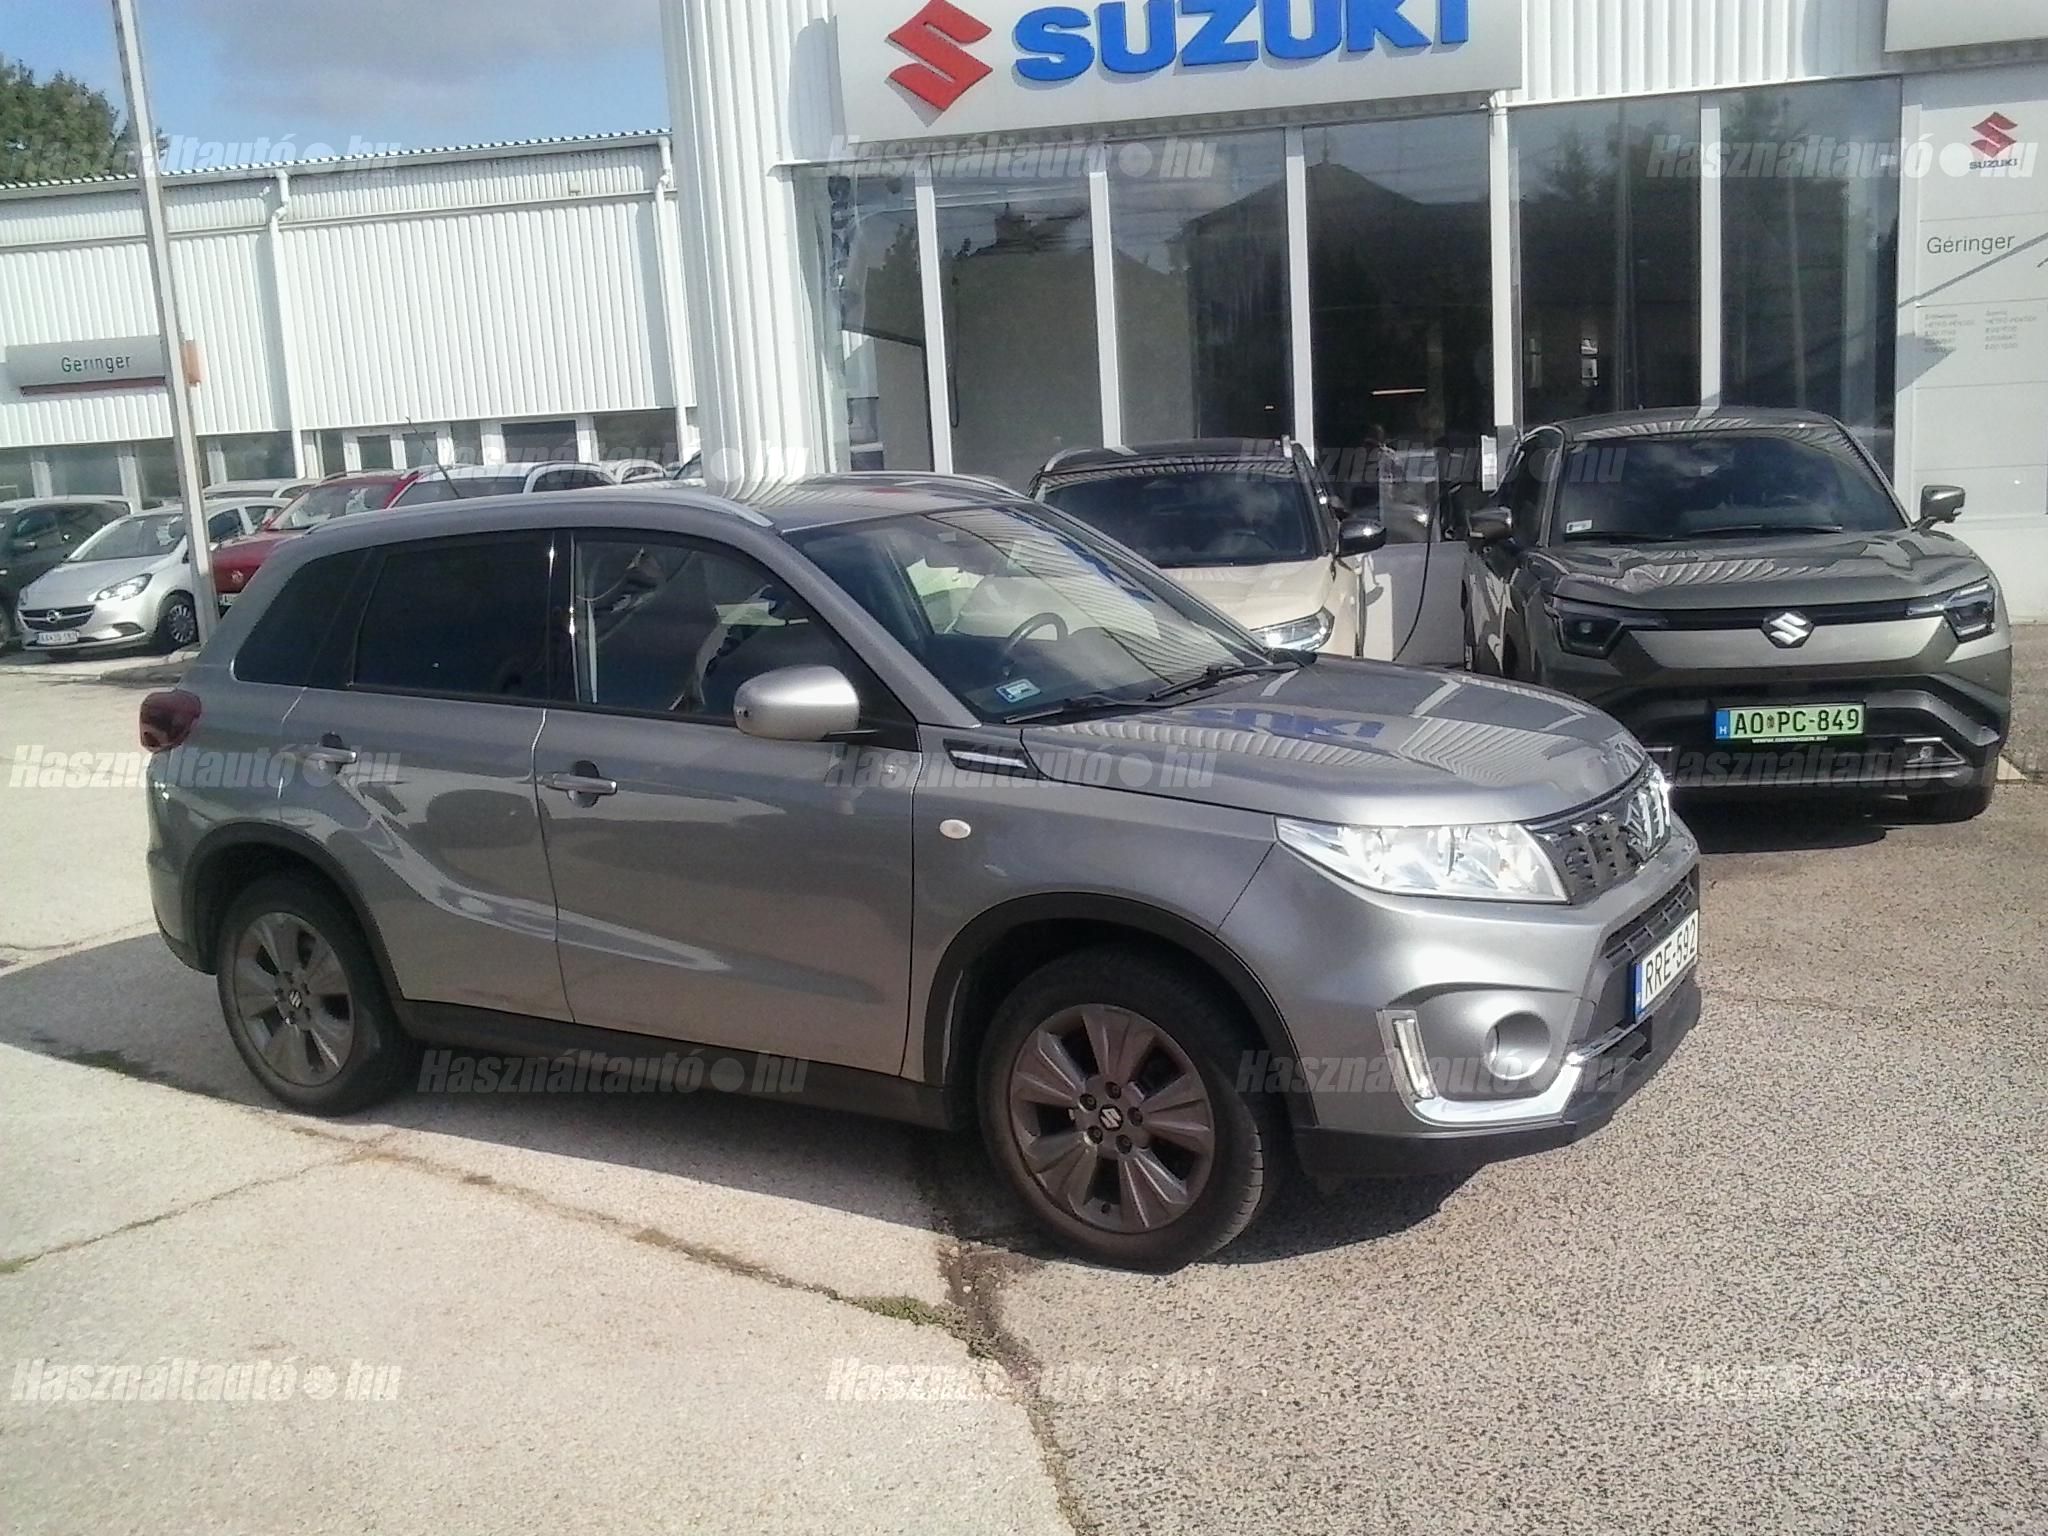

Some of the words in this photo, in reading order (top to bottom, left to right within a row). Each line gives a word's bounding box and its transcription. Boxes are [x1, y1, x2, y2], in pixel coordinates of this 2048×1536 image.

[1015, 0, 1468, 81] SUZUKI
[1969, 158, 2017, 169] SUZUKI
[1926, 234, 2015, 255] Géringer
[1777, 708, 1860, 733] PC-849
[1645, 918, 1696, 999] RRE-592
